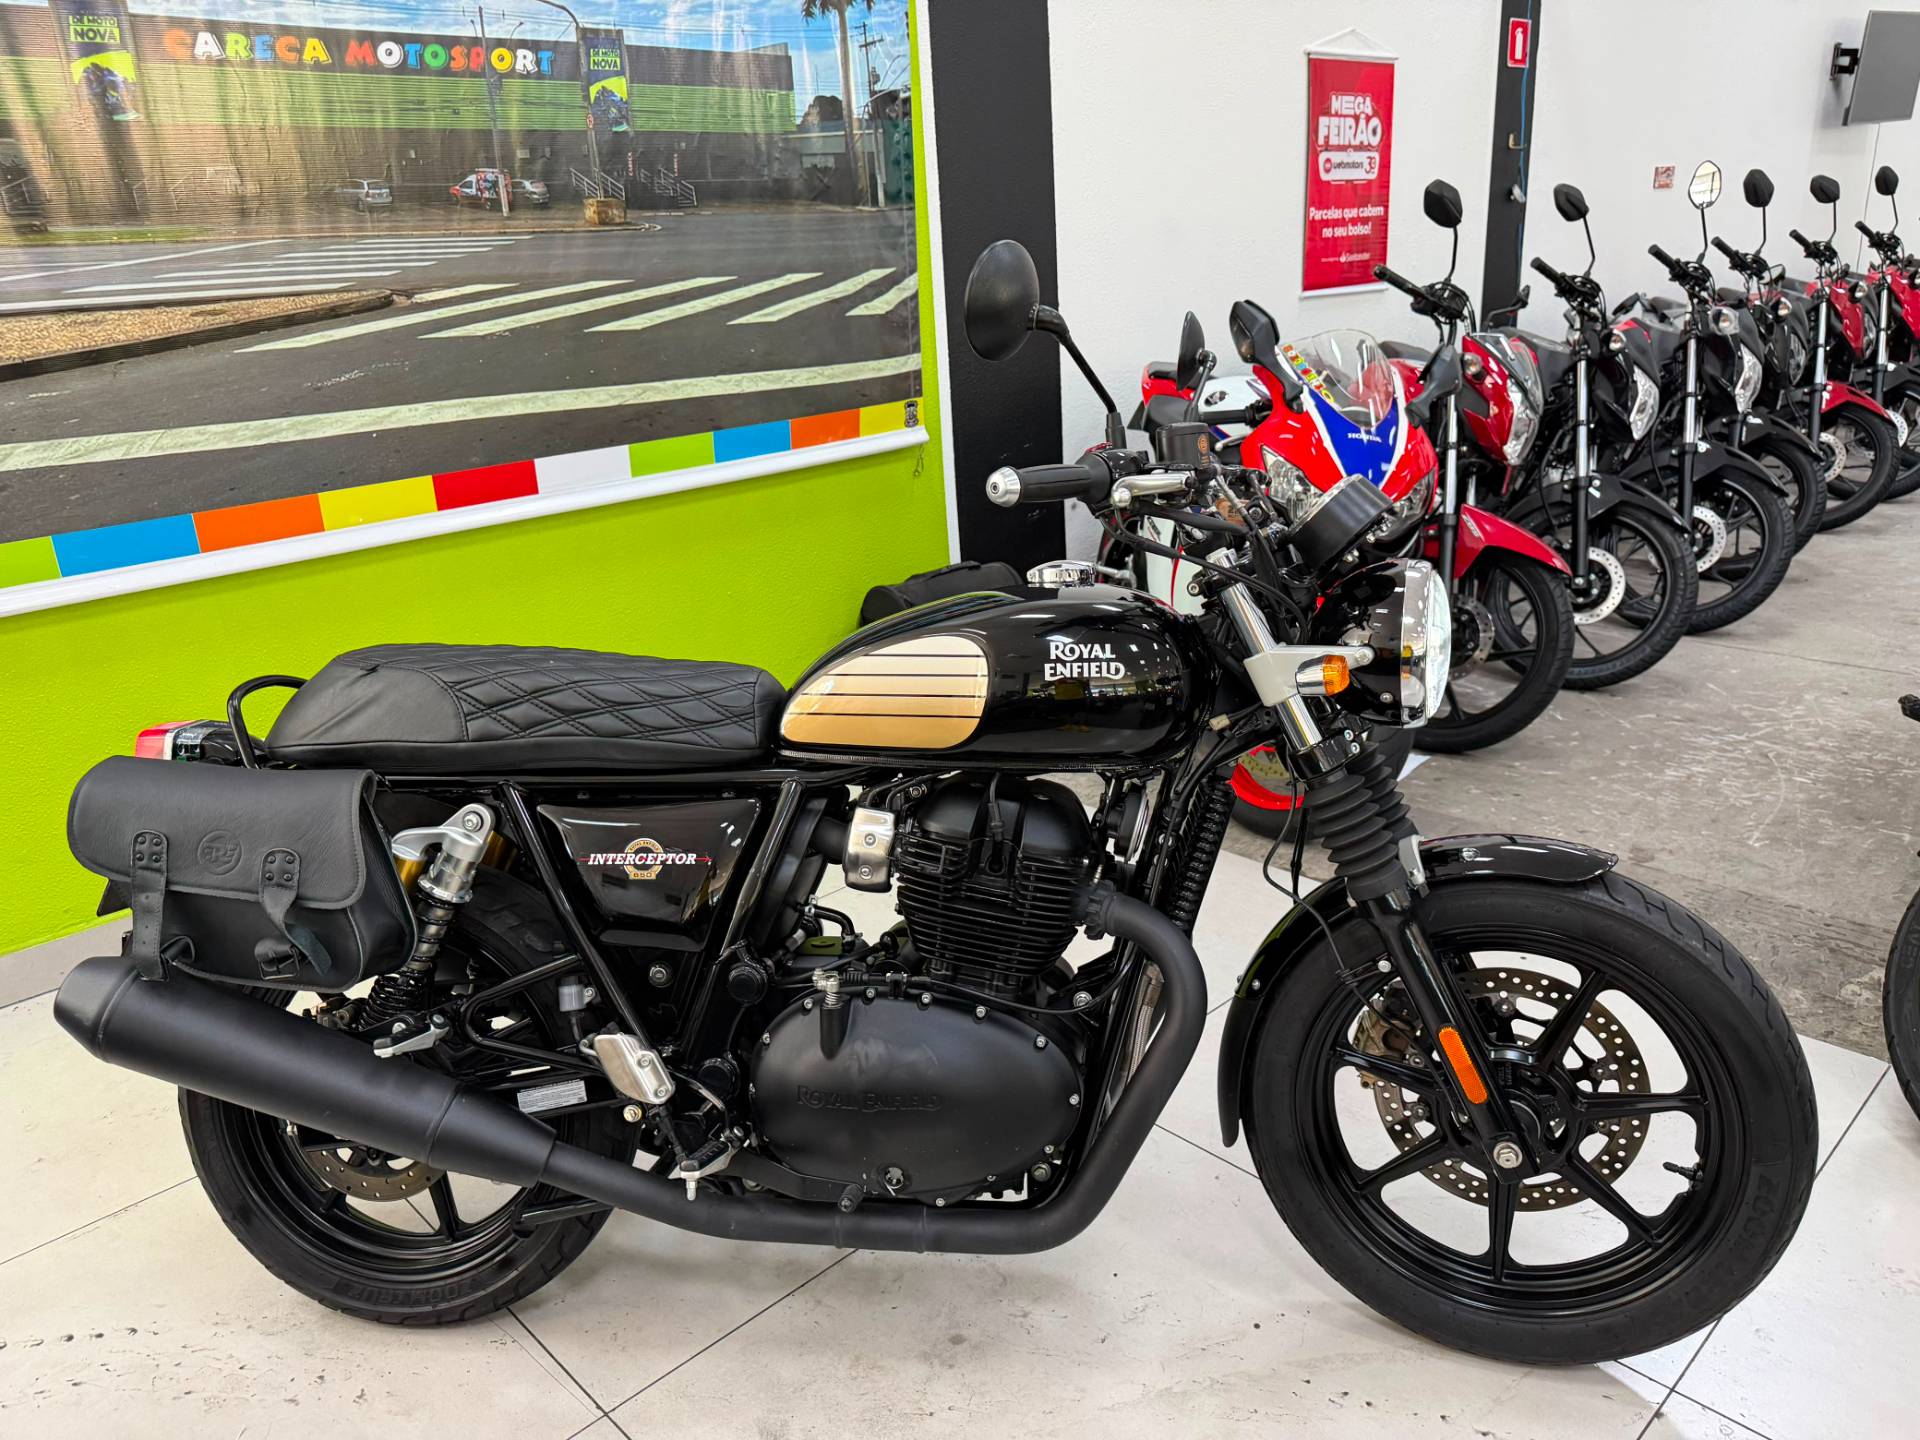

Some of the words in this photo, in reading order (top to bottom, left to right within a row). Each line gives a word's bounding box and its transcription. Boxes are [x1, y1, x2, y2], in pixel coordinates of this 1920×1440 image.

[73, 27, 118, 42] NOVA
[162, 27, 332, 65] CARECA
[344, 39, 555, 75] MOTOSPORT
[592, 58, 619, 69] NOVA
[1331, 94, 1373, 116] MEGA
[1318, 112, 1382, 147] FEIRÃO
[1309, 205, 1342, 220] Parcelas
[1343, 207, 1358, 221] que
[1358, 203, 1384, 218] cabem
[1322, 227, 1333, 238] no
[1334, 226, 1347, 237] seu
[1348, 222, 1372, 236] bolso!
[1347, 432, 1382, 443] HONDA
[1049, 641, 1117, 661] ROYAL
[1044, 661, 1126, 681] ENFIELD
[588, 853, 697, 865] INTERCEPTOR
